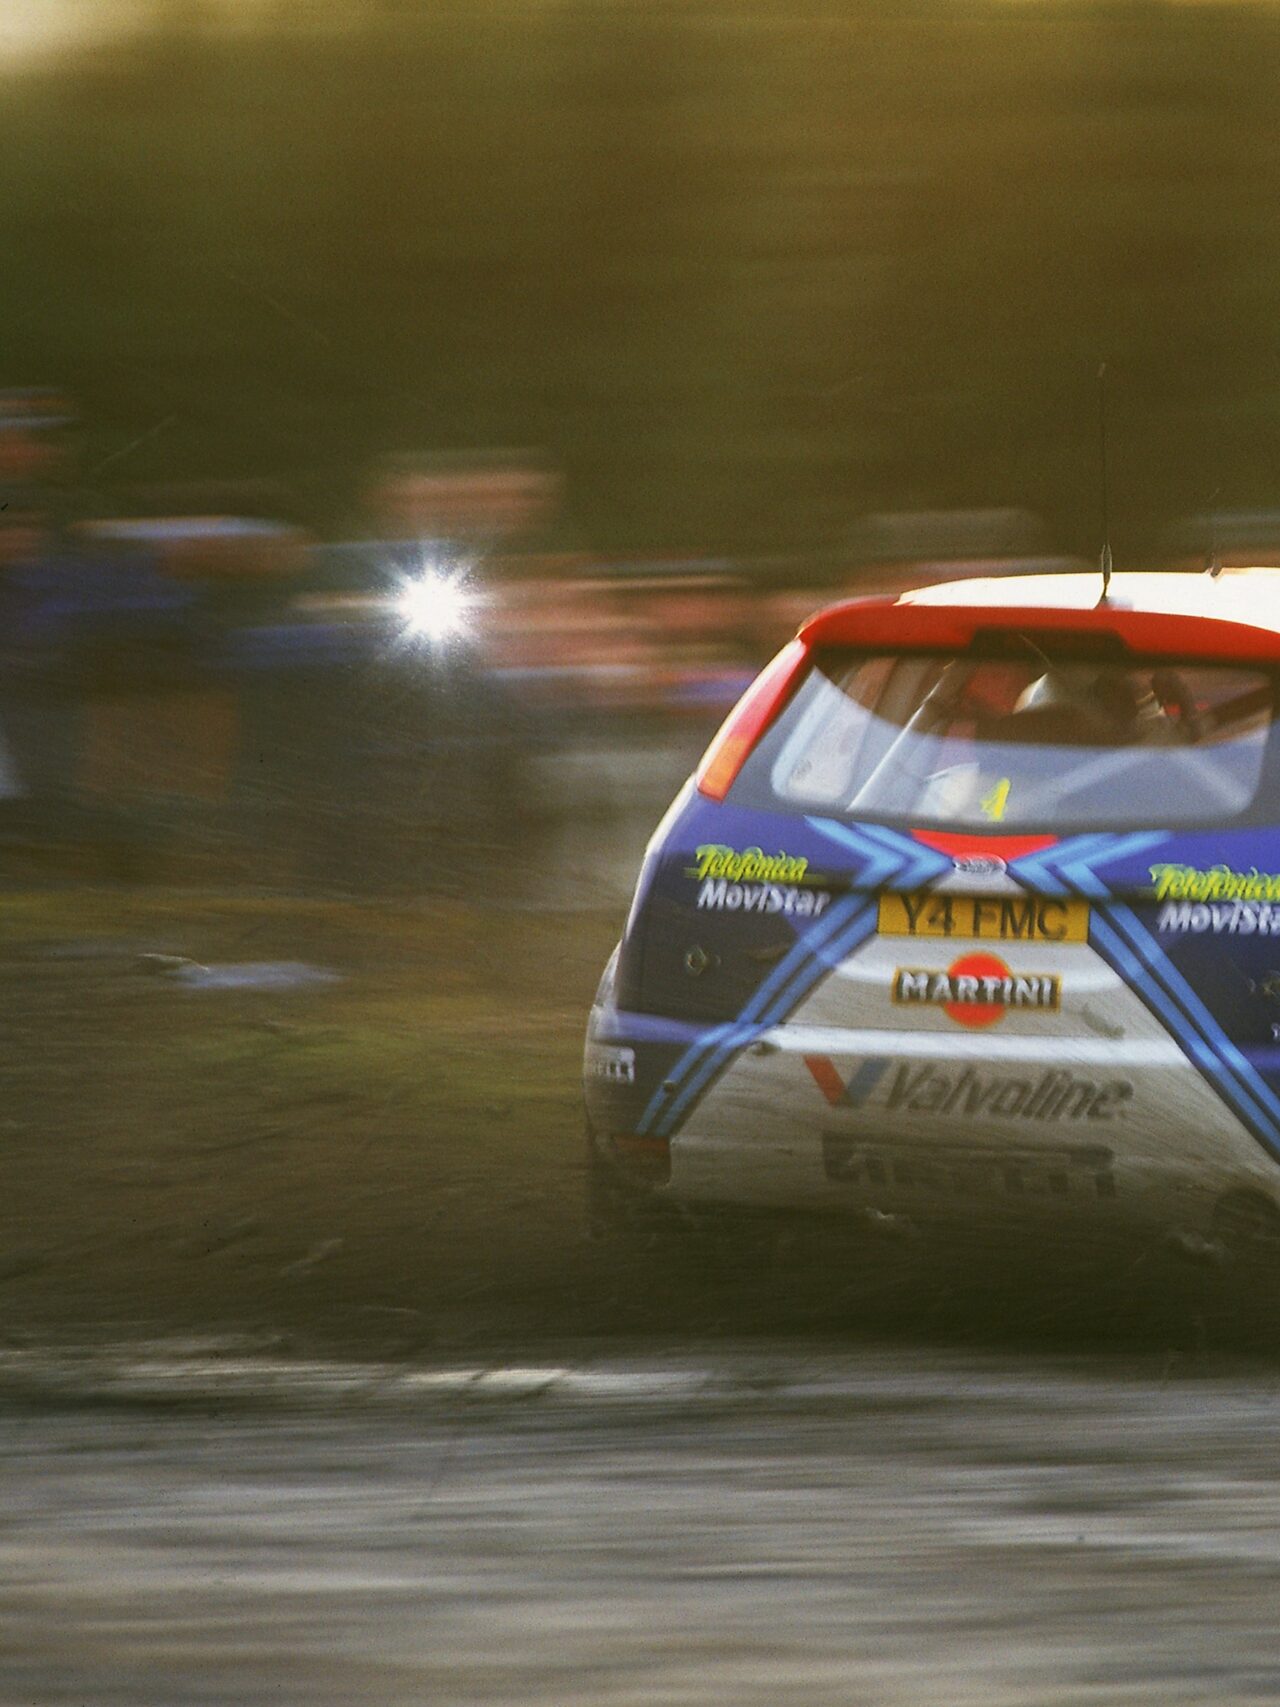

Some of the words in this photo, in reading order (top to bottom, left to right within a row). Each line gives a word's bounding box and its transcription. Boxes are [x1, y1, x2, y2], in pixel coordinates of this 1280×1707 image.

[901, 895, 955, 936] Y4
[973, 897, 1068, 941] FMC
[901, 970, 1052, 1007] MARTINI
[885, 1060, 1135, 1122] Valvoline
